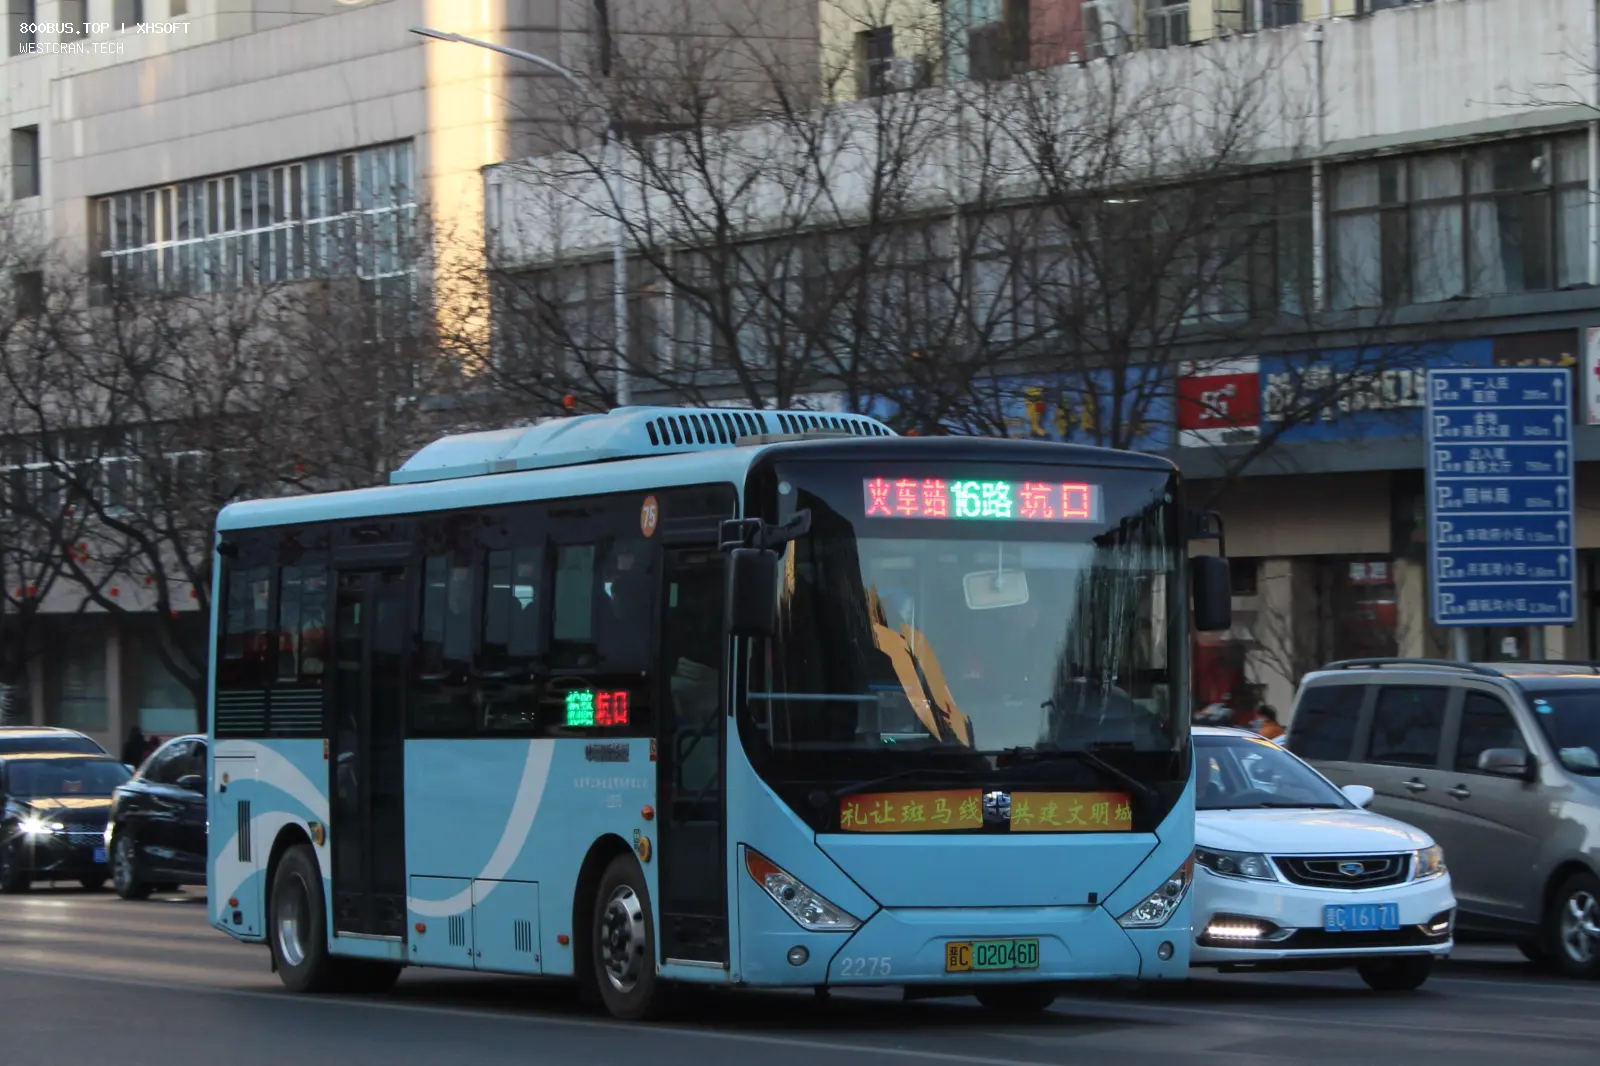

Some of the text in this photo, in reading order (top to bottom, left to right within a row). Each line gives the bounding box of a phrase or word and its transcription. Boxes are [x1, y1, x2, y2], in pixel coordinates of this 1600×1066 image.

[866, 477, 1091, 519] 火车站 16路 坑口
[841, 795, 983, 827] 礼让斑马线
[1010, 798, 1133, 827] 共建文明城
[840, 956, 892, 977] 2275
